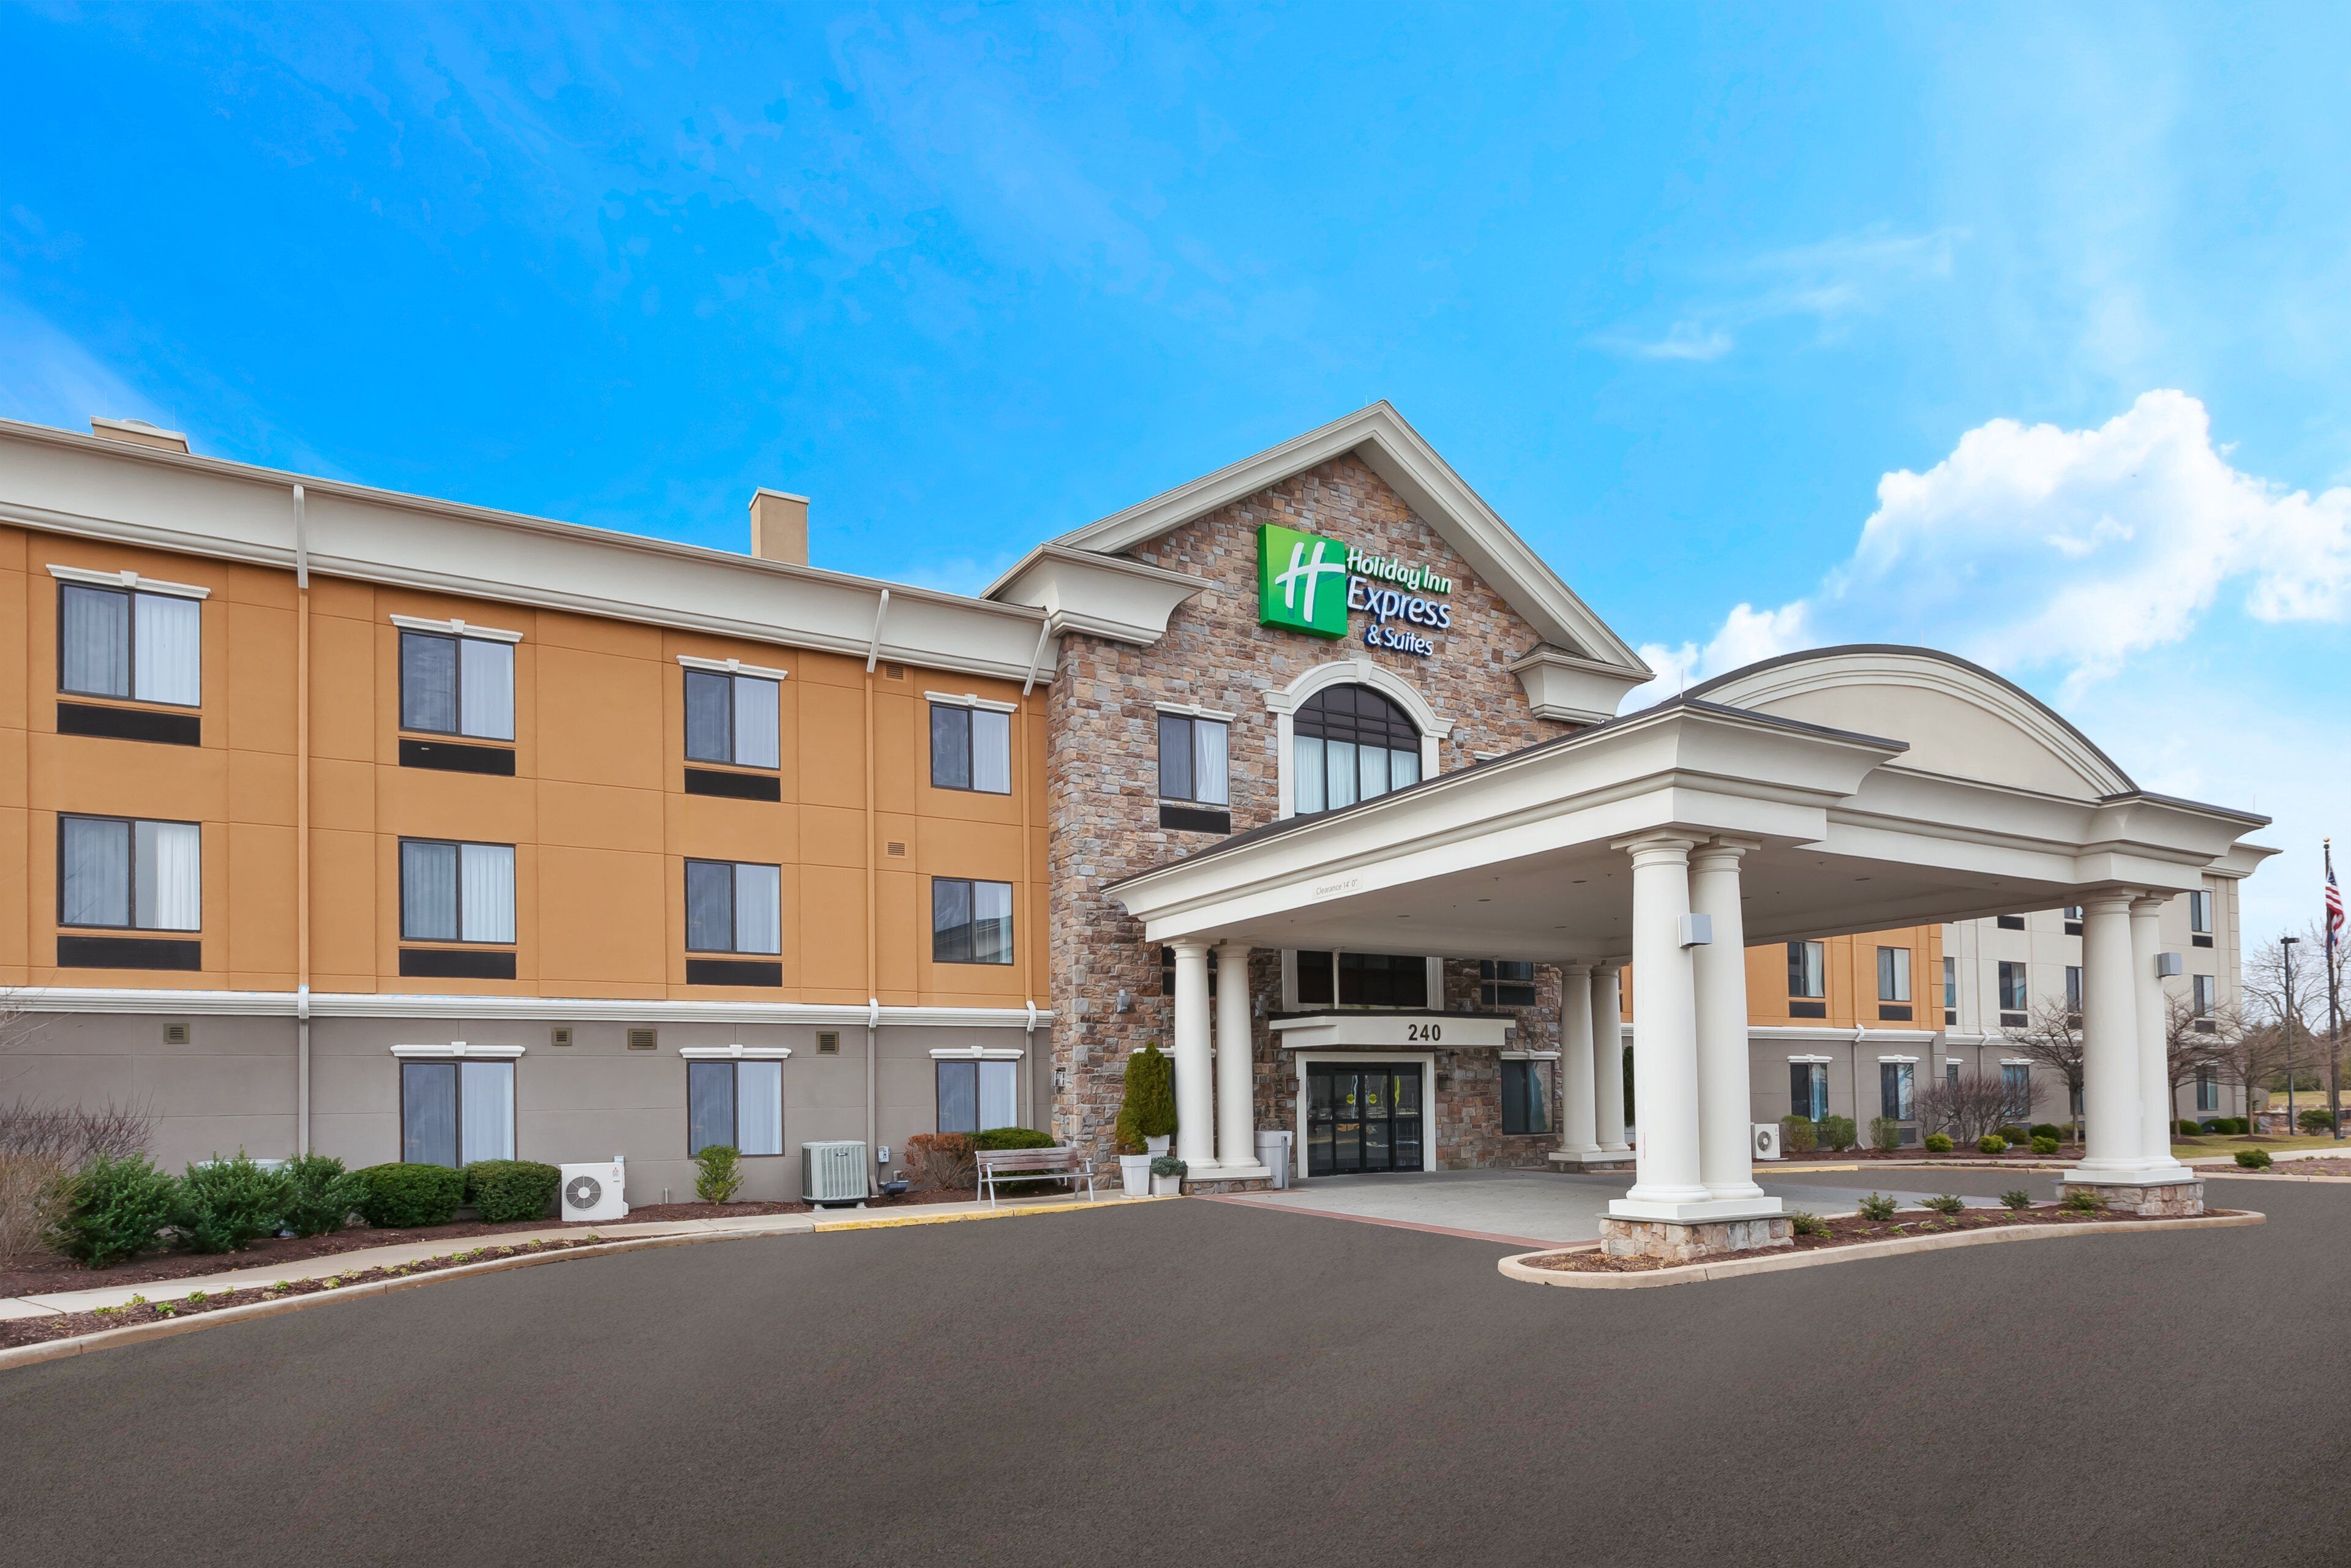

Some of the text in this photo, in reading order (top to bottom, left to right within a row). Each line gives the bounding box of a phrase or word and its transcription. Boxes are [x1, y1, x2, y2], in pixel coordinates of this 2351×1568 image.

[1347, 546, 1452, 594] Holiday Inn
[1347, 575, 1452, 628] Express
[1367, 624, 1434, 656] & Suites
[1316, 884, 1341, 895] Clearance
[1408, 1024, 1441, 1041] 240
